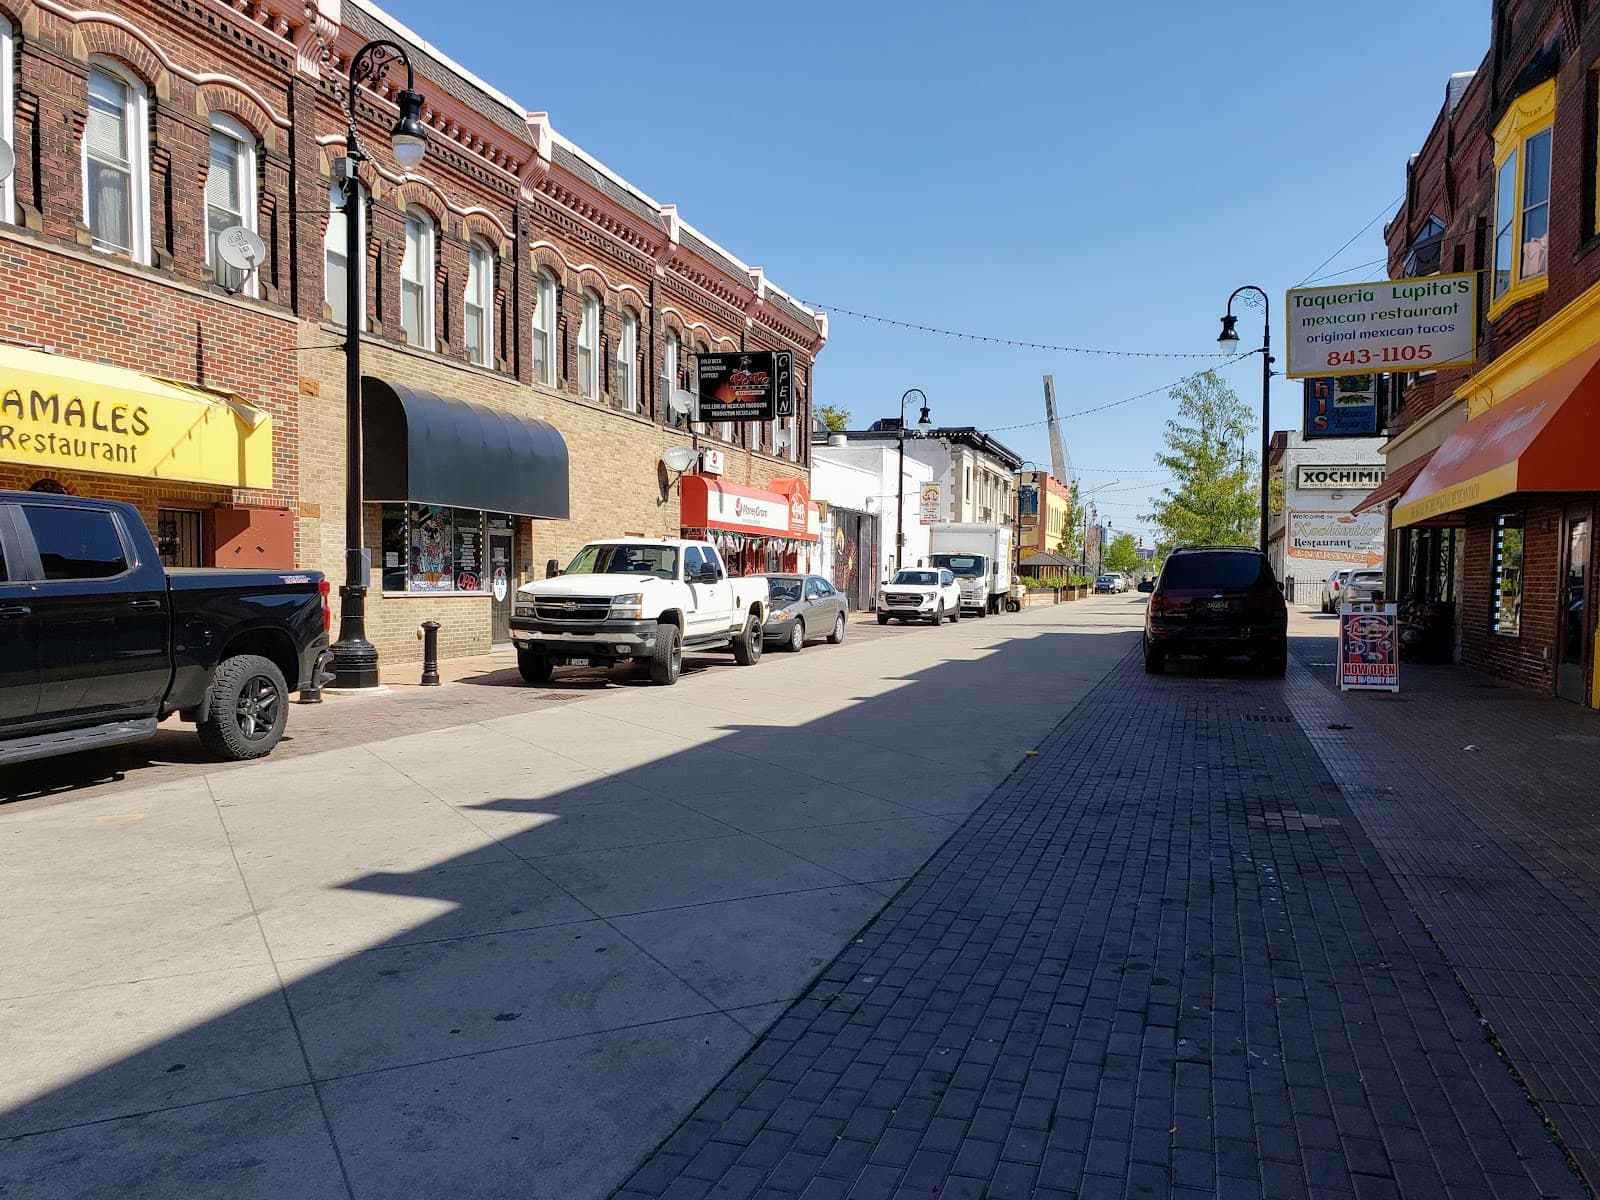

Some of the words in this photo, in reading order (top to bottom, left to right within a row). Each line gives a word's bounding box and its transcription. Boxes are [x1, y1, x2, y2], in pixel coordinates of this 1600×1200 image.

[1293, 289, 1374, 311] Taqueria
[1302, 312, 1366, 327] mexican
[1370, 302, 1460, 321] restaurant
[1306, 329, 1356, 345] original
[1359, 326, 1414, 339] mexican
[1417, 323, 1455, 334] tacos
[1326, 344, 1433, 366] 843-1105
[778, 355, 789, 412] OPEN
[1, 389, 151, 437] AMALES
[0, 425, 138, 464] Restaurant
[1294, 538, 1352, 548] Restaurant
[1296, 549, 1368, 563] ENTRANCE
[457, 572, 479, 591] OPEN
[1344, 663, 1368, 675] NOW
[1370, 663, 1396, 675] OPEN
